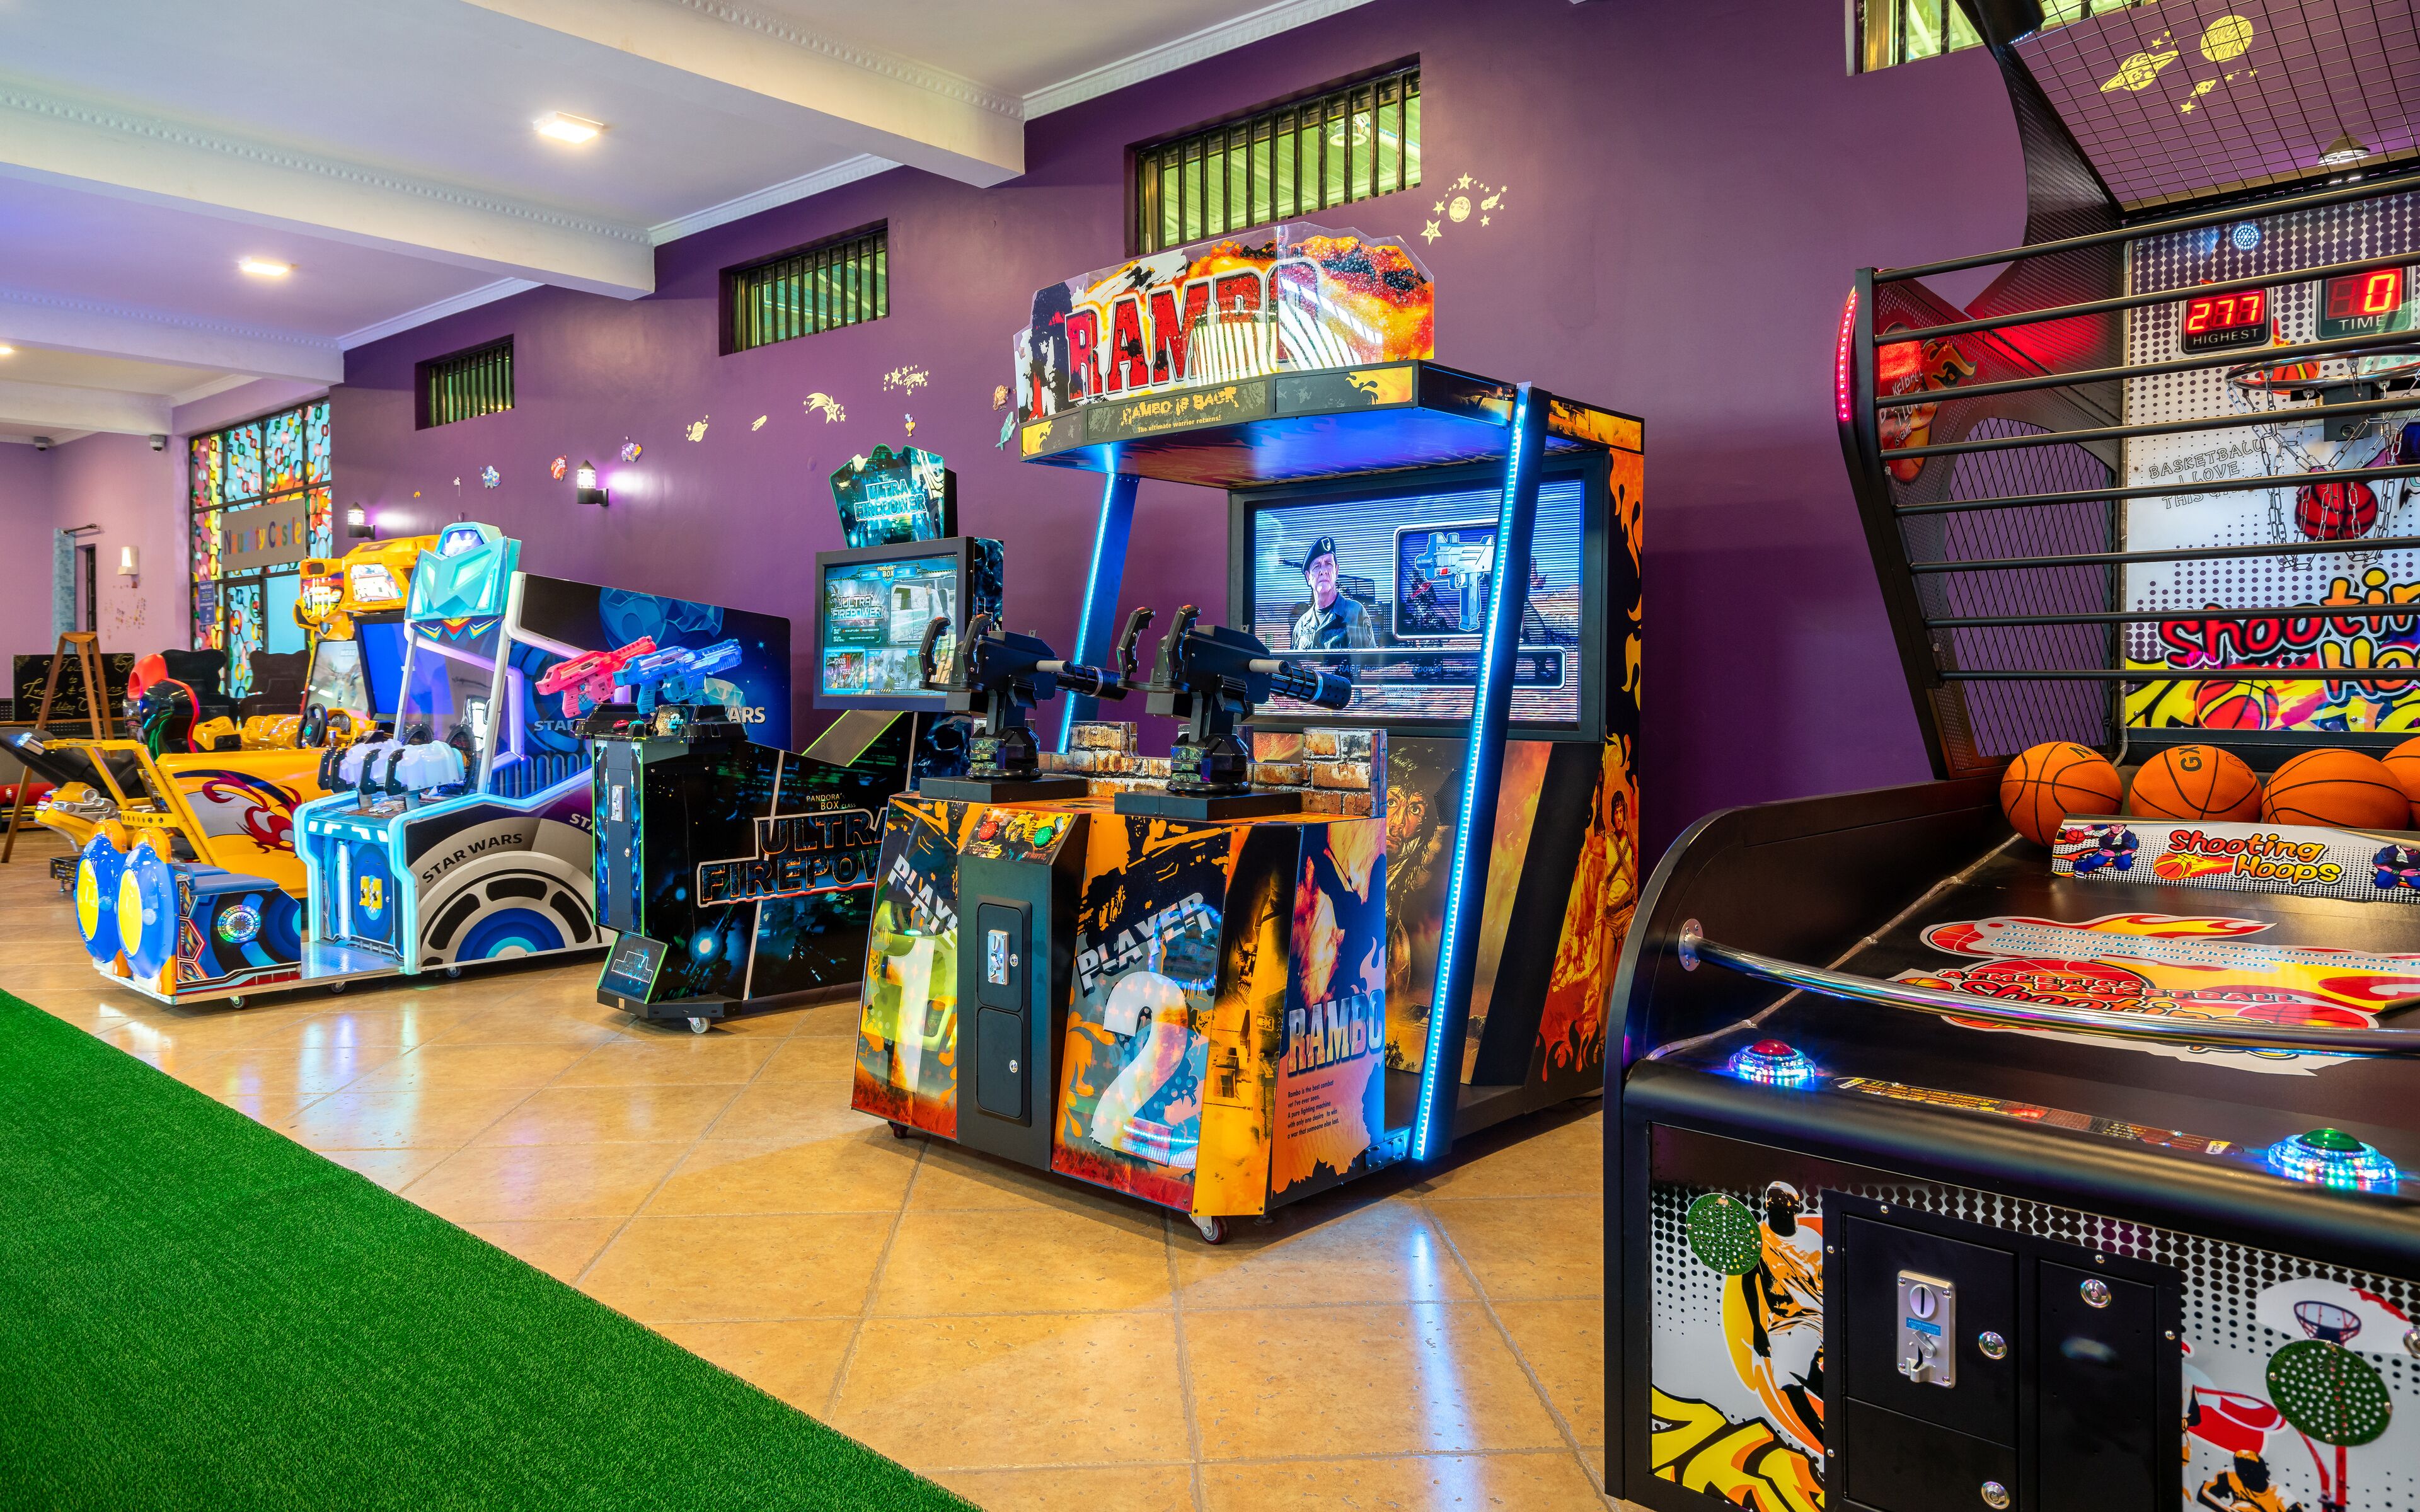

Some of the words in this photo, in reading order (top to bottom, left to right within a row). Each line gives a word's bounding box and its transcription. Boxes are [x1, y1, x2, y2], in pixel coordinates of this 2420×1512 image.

[2188, 295, 2259, 331] 277
[2338, 316, 2386, 331] TIME
[1065, 258, 1320, 403] RAMBO
[2193, 328, 2259, 345] HIGHEST
[1193, 386, 1239, 410] BACK
[1196, 415, 1221, 423] returns!
[867, 479, 910, 500] ULTRA
[856, 495, 926, 520] FIREPOWER
[224, 527, 266, 555] Naughty
[268, 517, 302, 548] Castle
[833, 606, 882, 620] FIREPOWER
[842, 596, 872, 608] ULTRA
[666, 713, 680, 729] 2
[725, 706, 766, 724] ARS
[806, 793, 845, 801] PANDORA'S
[821, 801, 839, 810] BOX
[2168, 829, 2327, 862] Shooting
[422, 849, 467, 883] STAR
[468, 833, 522, 854] WARS
[701, 848, 880, 901] FIREPOW
[2234, 854, 2344, 885] Hoops
[1077, 892, 1214, 992] PLAYER
[1988, 942, 2102, 959] cooperation
[2002, 930, 2087, 944] attention
[2114, 941, 2193, 955] keeping
[2197, 949, 2249, 959] their
[2253, 955, 2297, 964] own
[2302, 959, 2400, 973] portable
[2009, 924, 2040, 932] You
[2068, 929, 2097, 937] the
[2101, 934, 2153, 943] game
[2218, 944, 2271, 954] same
[2276, 949, 2326, 958] time
[2331, 954, 2404, 965] please
[2083, 946, 2141, 956] thank
[2143, 952, 2182, 960] you
[2220, 959, 2272, 969] your
[2035, 983, 2301, 1003] BASKETBALL
[887, 939, 935, 1093] 1
[1288, 990, 1383, 1075] RAMBO
[1091, 971, 1199, 1169] 2
[1288, 1089, 1301, 1097] Rambo
[1321, 1080, 1334, 1089] combat
[1291, 1111, 1299, 1119] pure
[1301, 1106, 1315, 1115] fighting
[1316, 1101, 1331, 1109] machine
[1312, 1113, 1323, 1121] desire
[1307, 1125, 1323, 1133] someone
